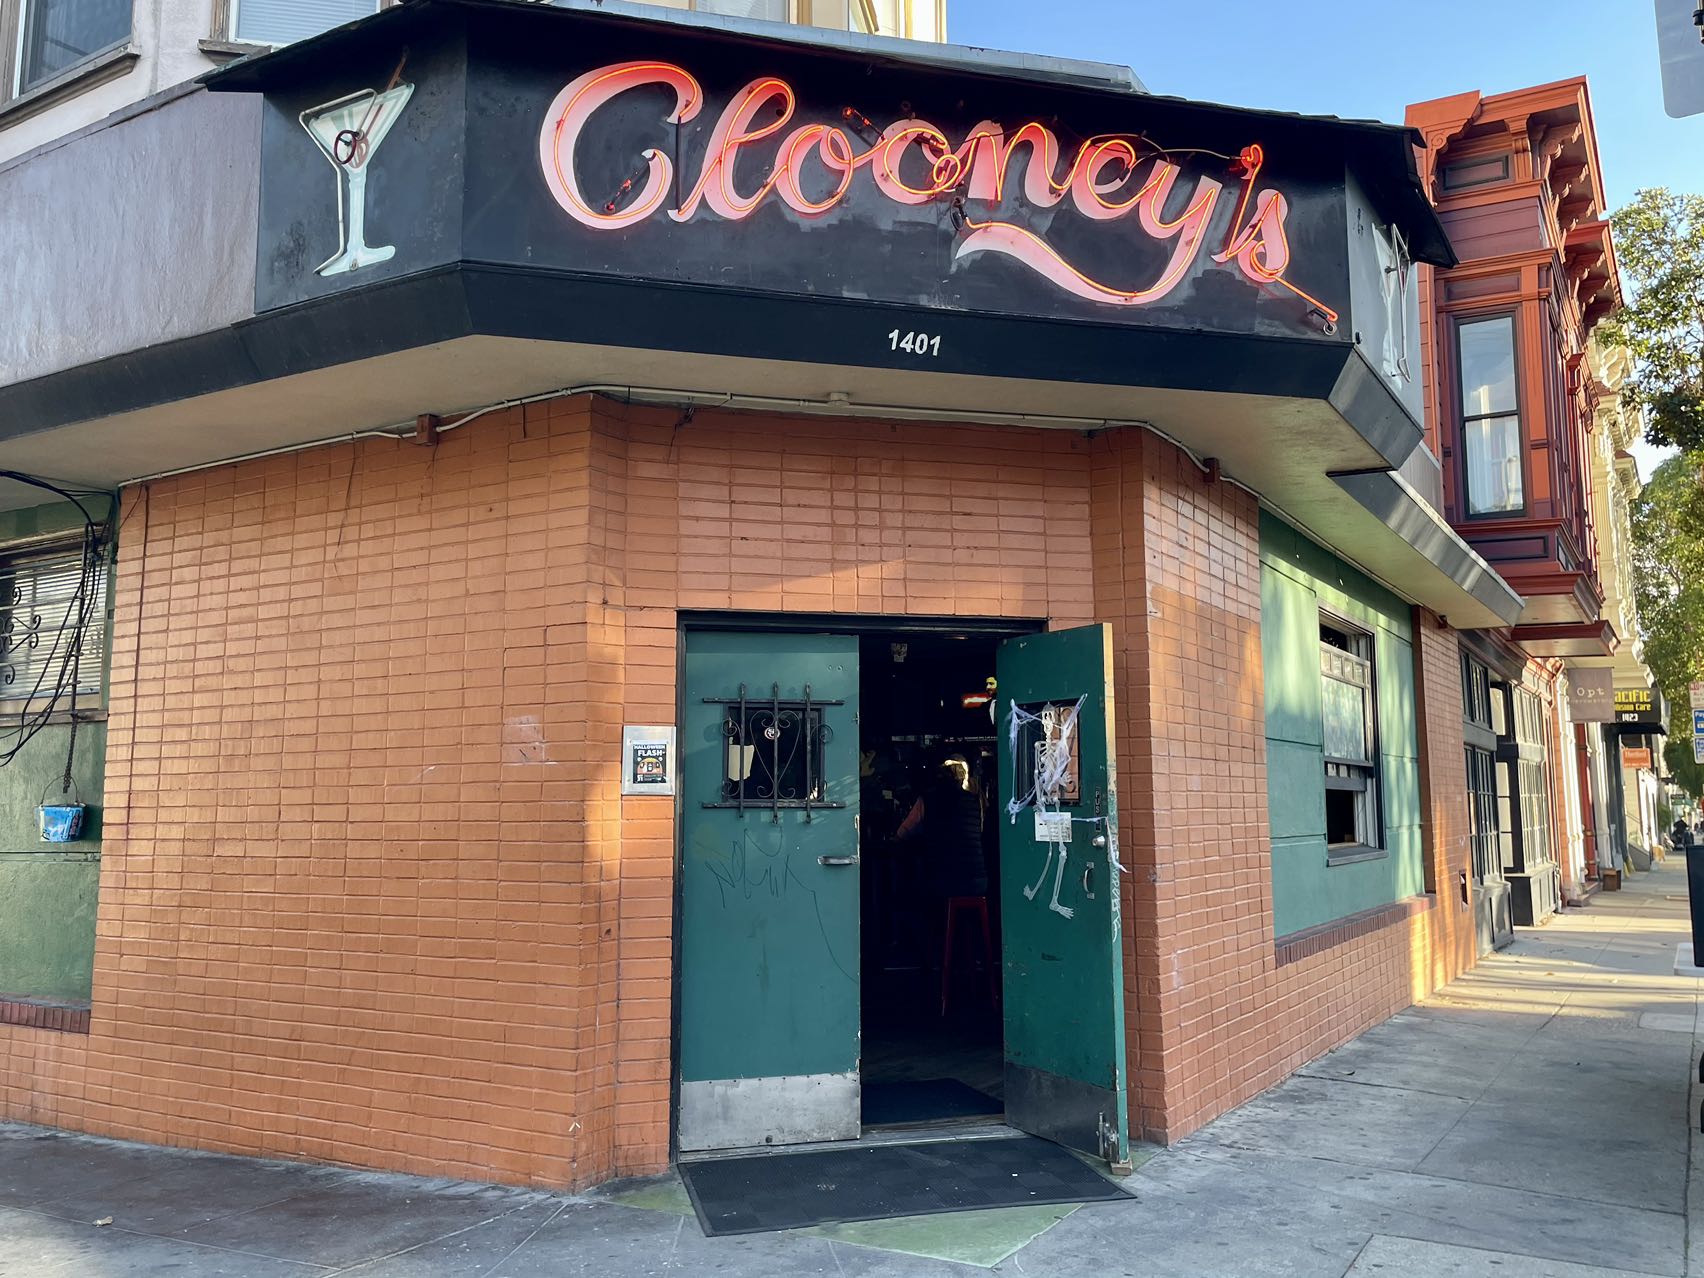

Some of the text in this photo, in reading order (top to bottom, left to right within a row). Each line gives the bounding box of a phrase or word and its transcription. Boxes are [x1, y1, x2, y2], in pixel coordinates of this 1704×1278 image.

[539, 60, 1290, 306] Clooney's
[888, 329, 941, 357] 1401
[1576, 687, 1605, 698] Opt
